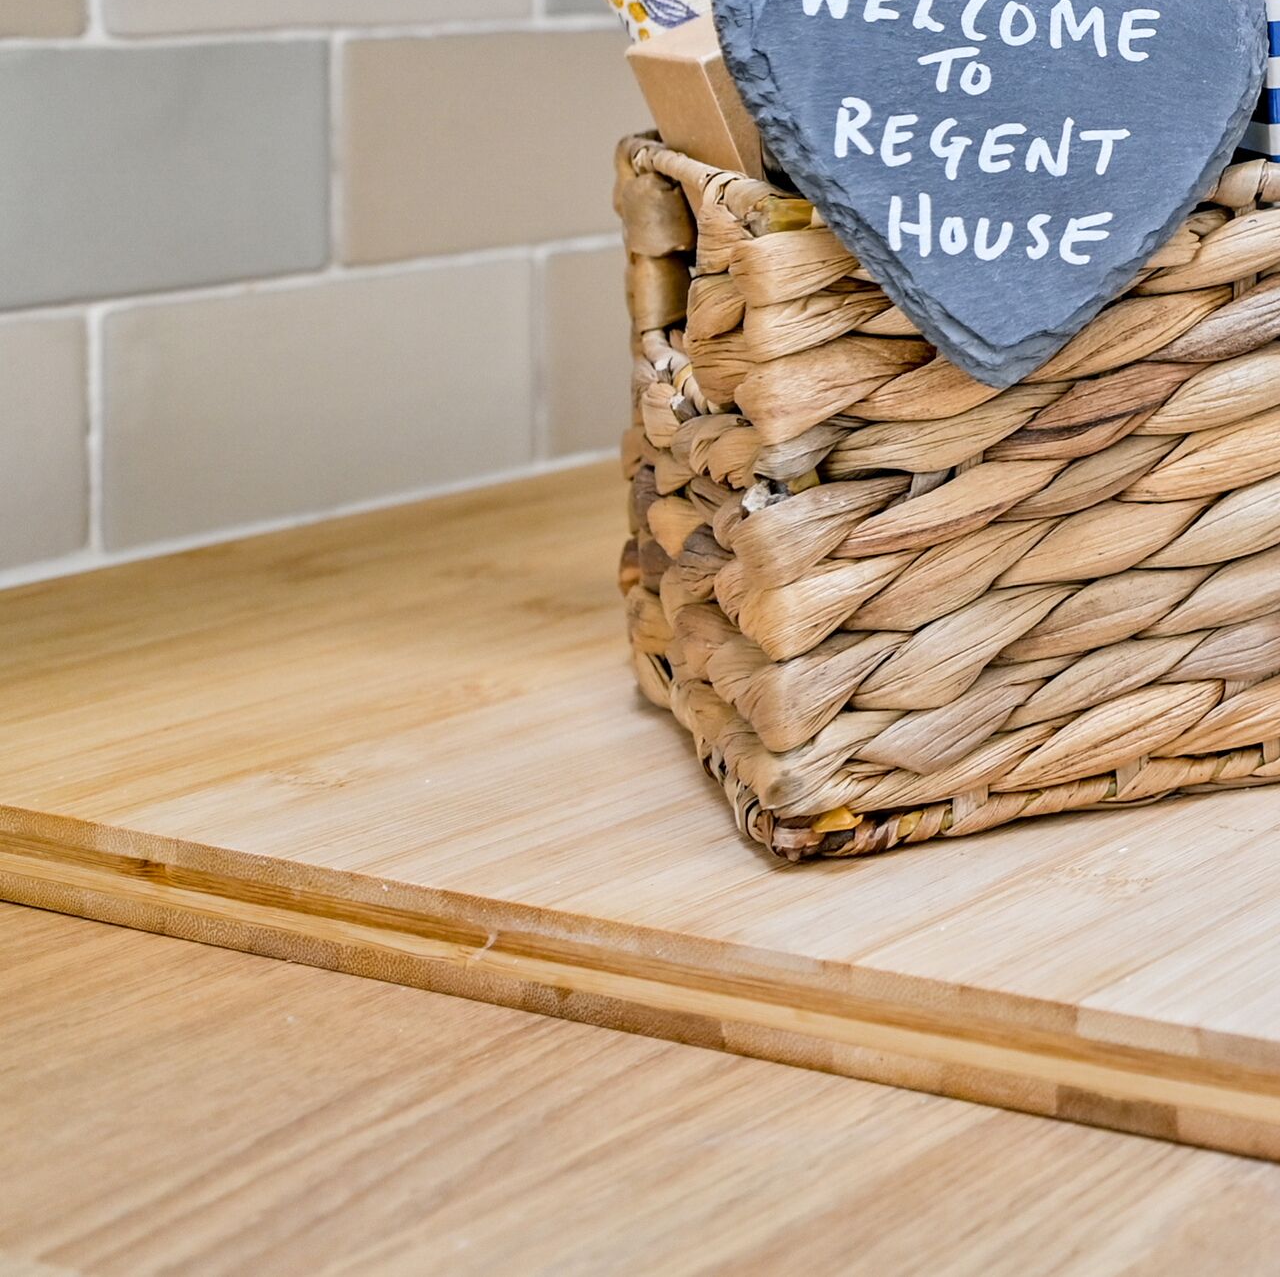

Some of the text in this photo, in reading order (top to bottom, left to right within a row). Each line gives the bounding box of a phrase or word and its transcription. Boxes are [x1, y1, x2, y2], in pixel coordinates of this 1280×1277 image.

[917, 46, 993, 96] TO
[834, 97, 1131, 181] REGENT
[888, 192, 1114, 265] HOUSE
